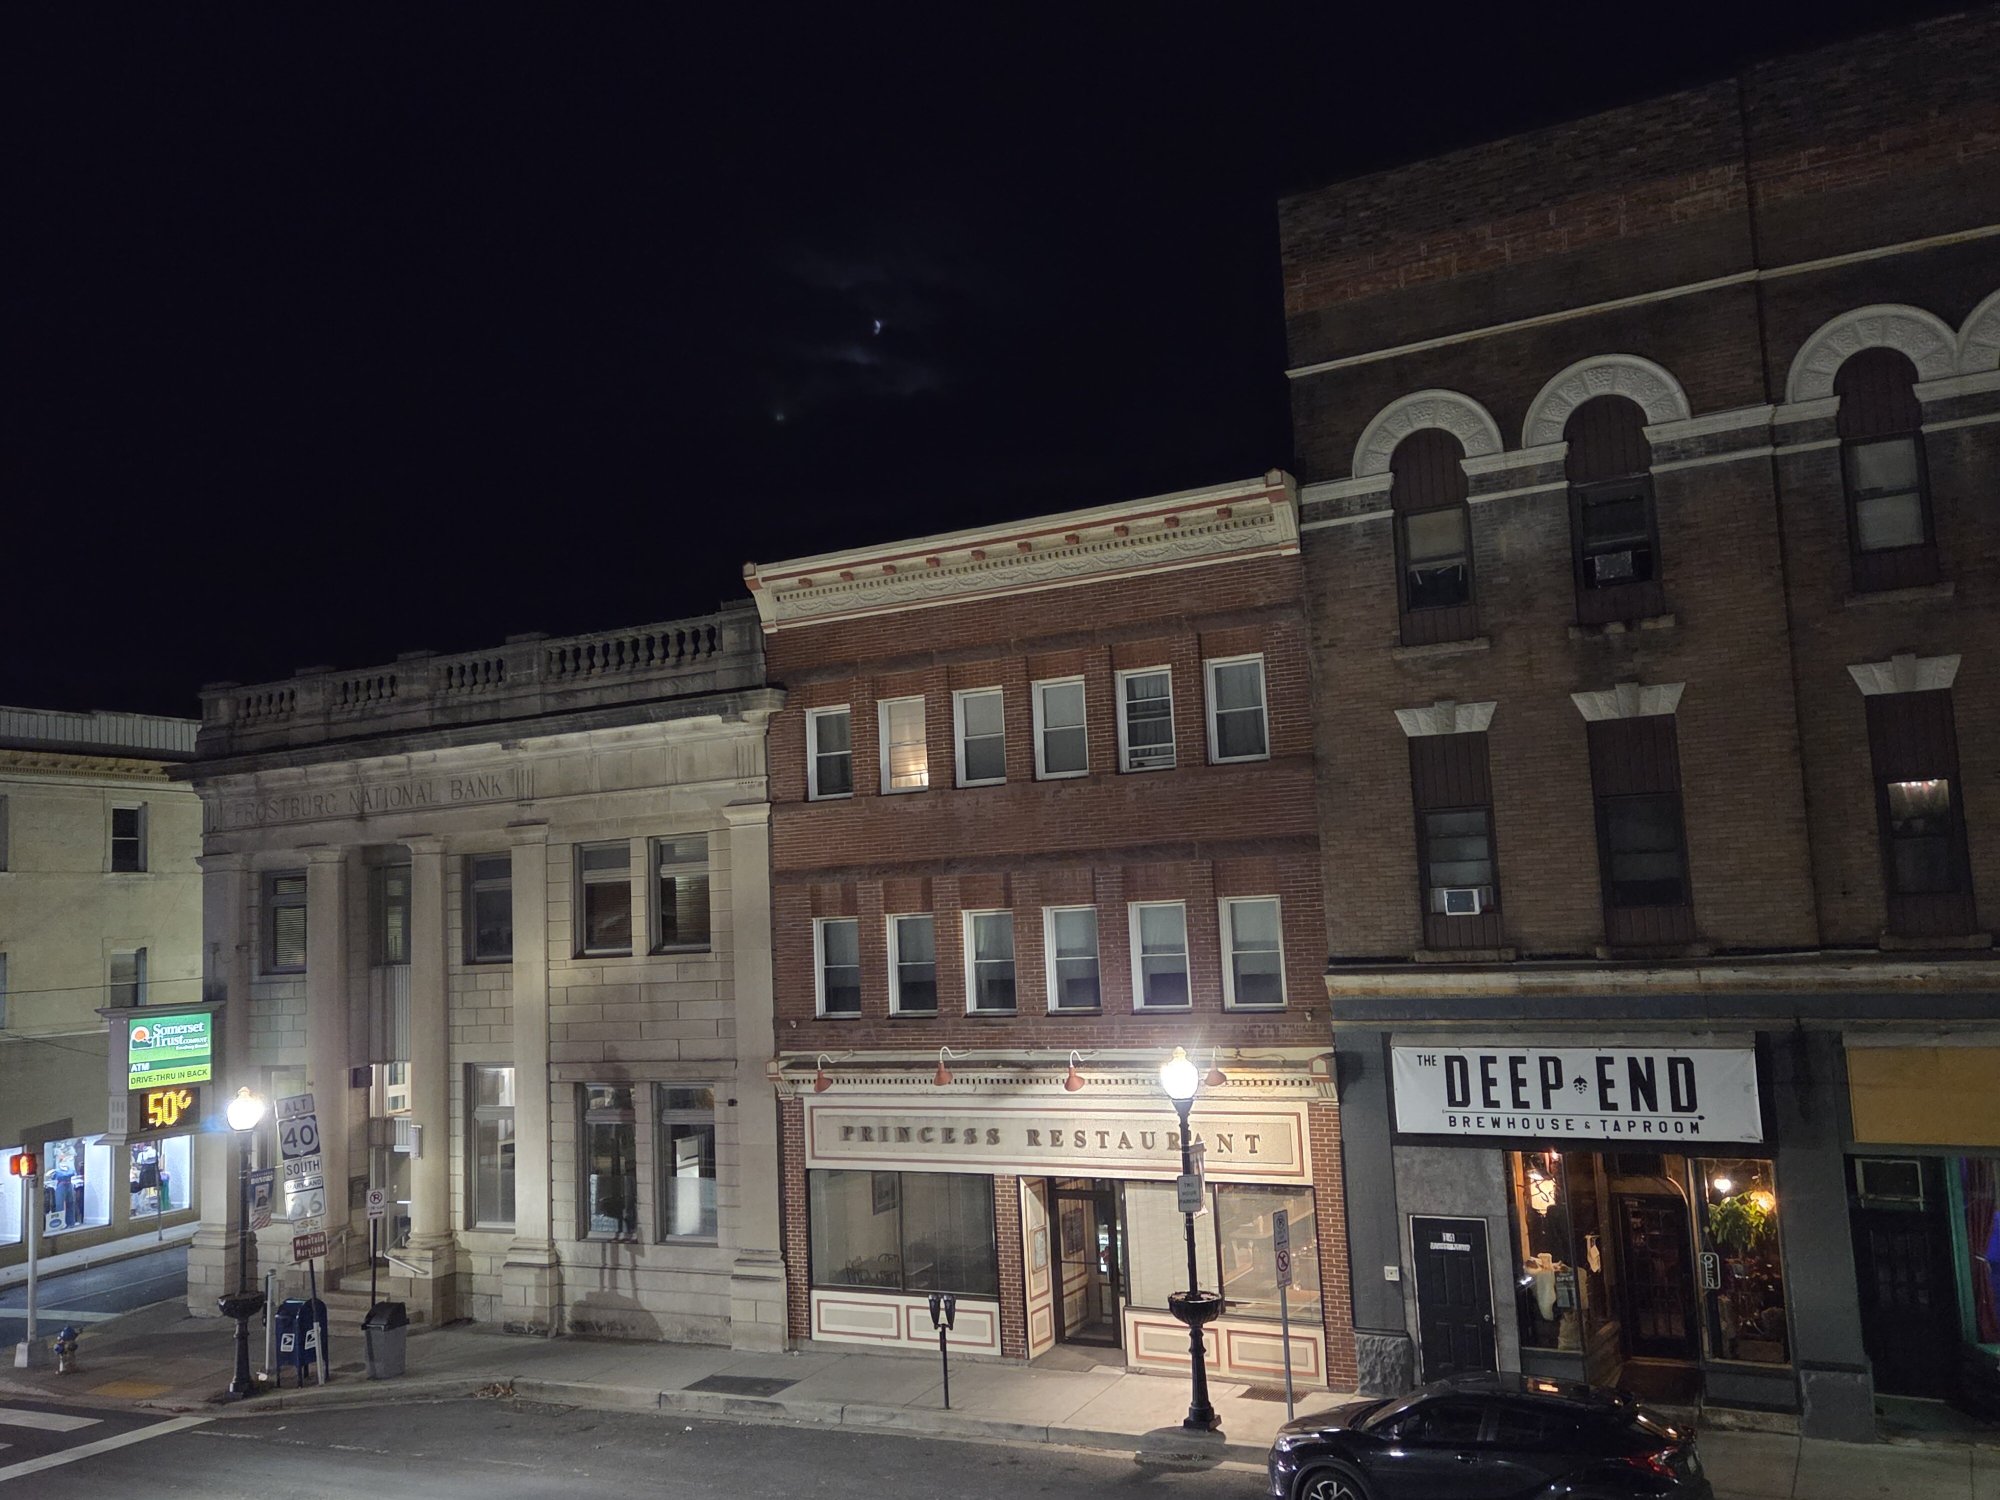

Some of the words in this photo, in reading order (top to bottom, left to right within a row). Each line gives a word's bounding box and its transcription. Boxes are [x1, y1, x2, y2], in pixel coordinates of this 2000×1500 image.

[349, 779, 440, 812] NATIONAL
[450, 775, 503, 801] BANK
[153, 1022, 204, 1036] Somerset
[153, 1035, 184, 1047] Trust
[131, 1062, 150, 1072] ATM
[131, 1073, 176, 1084] DRIVE-THRU
[178, 1071, 185, 1079] IN
[187, 1069, 208, 1078] BACK
[1416, 1054, 1437, 1067] THE
[1444, 1055, 1564, 1110] DEEP
[1595, 1056, 1699, 1113] END
[285, 1099, 306, 1114] ALT
[1448, 1115, 1575, 1132] BREWHOUSE
[1584, 1121, 1591, 1130] &
[1600, 1119, 1700, 1134] TAPROOM
[283, 1125, 314, 1148] 40
[839, 1125, 1001, 1146] PRINCESS
[1026, 1128, 1260, 1154] RESTAURANT
[286, 1161, 320, 1176] SOUTH
[295, 1235, 324, 1247] Mountain
[296, 1245, 325, 1257] Maryland
[1703, 1254, 1714, 1288] OPEN
